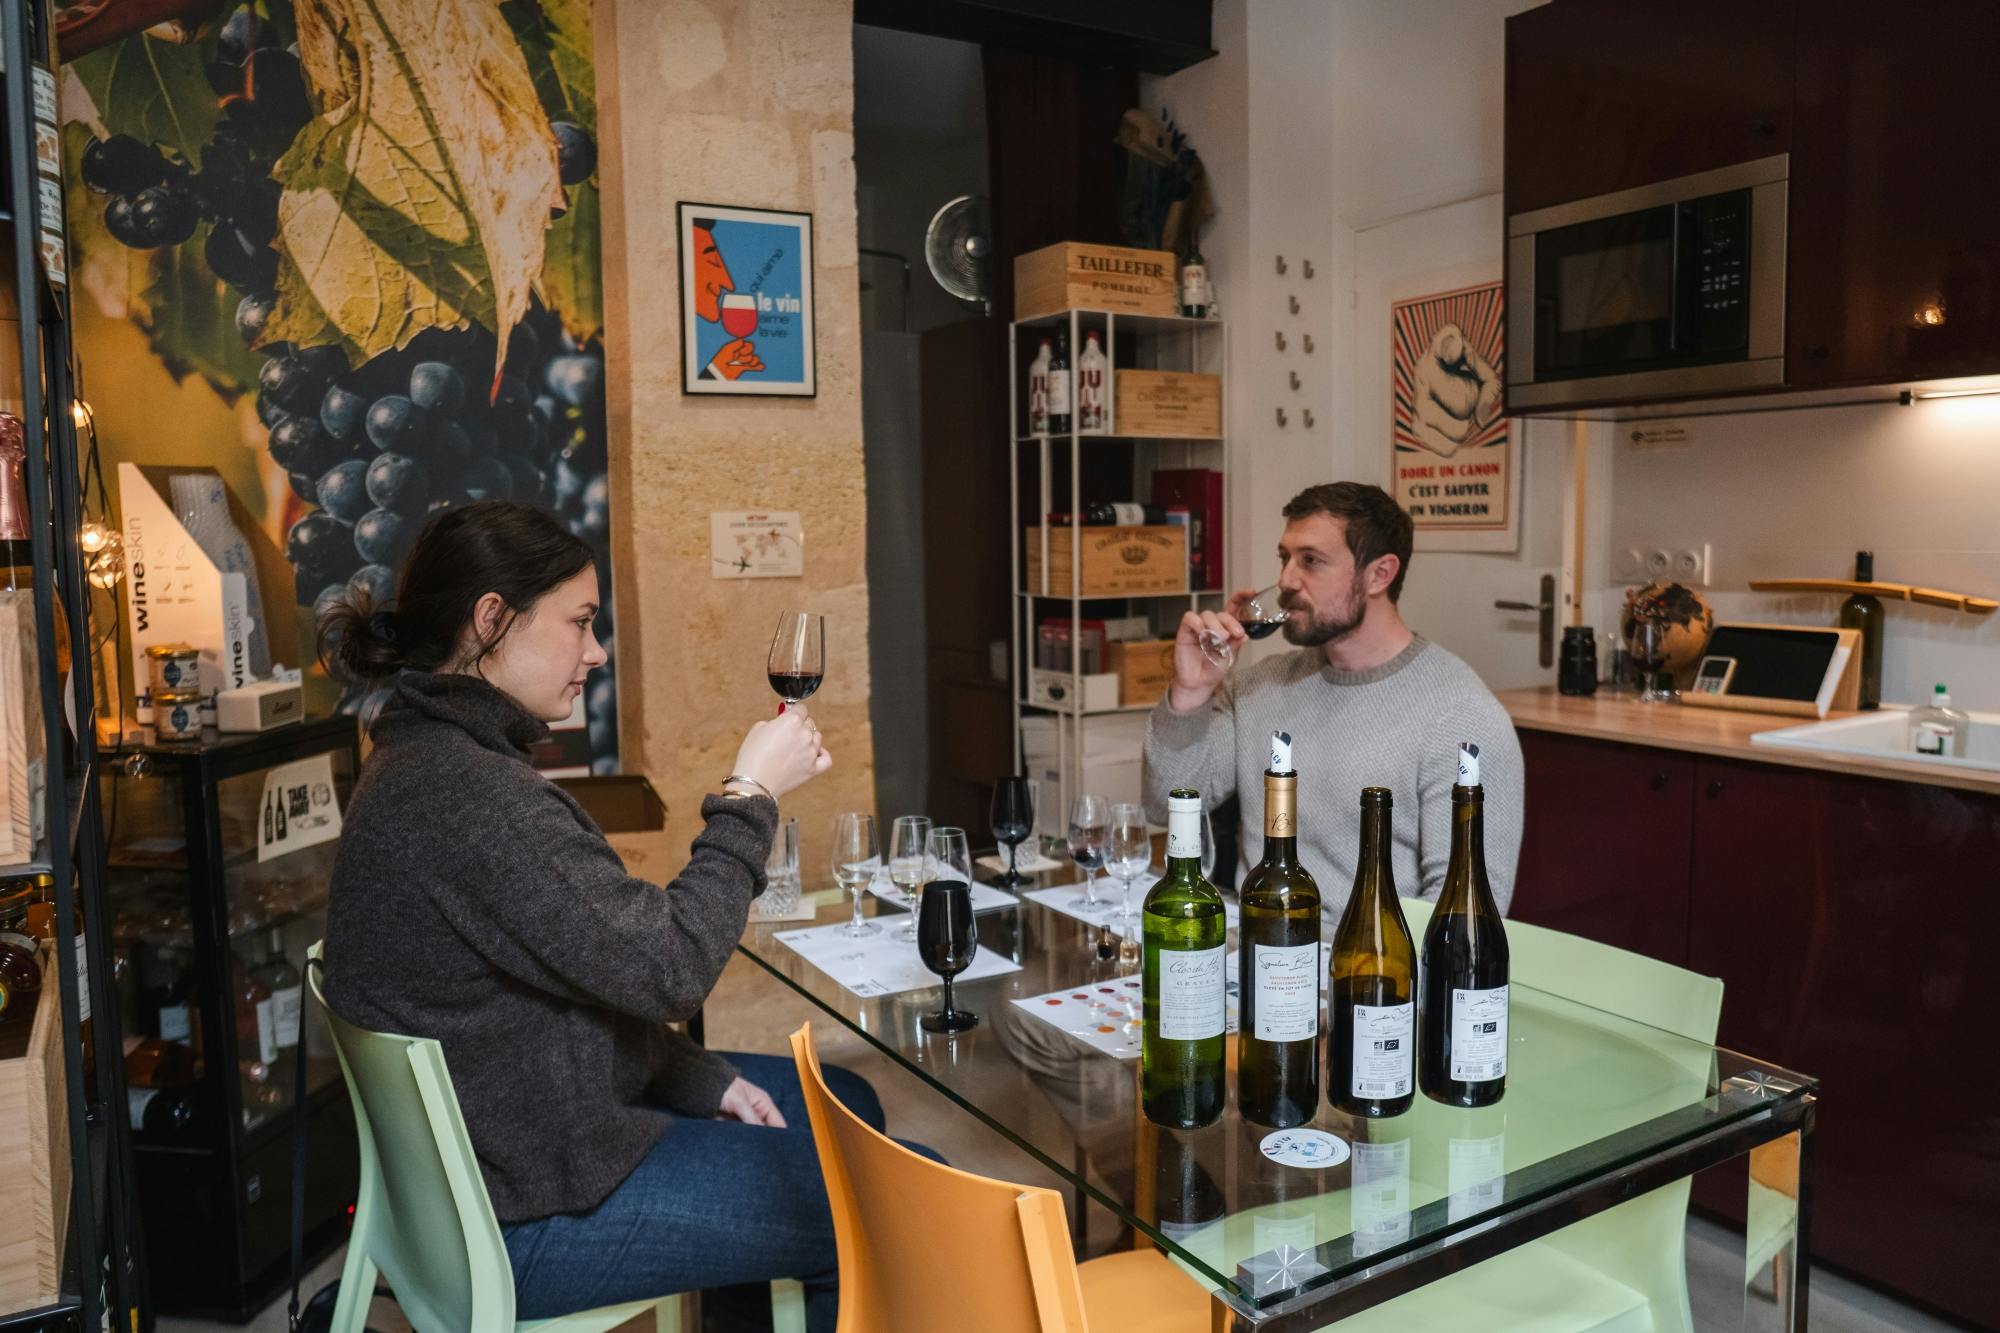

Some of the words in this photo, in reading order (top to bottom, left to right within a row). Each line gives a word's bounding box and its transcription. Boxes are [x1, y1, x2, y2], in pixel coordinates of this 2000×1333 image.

[751, 273, 764, 294] qui
[763, 248, 784, 278] aime
[1077, 255, 1164, 278] TAILLEFER
[757, 292, 773, 312] le
[776, 293, 800, 313] vin
[758, 315, 790, 325] aime
[1400, 467, 1434, 479] BOIRE
[1440, 465, 1455, 478] UN
[1460, 463, 1500, 477] CANON
[1409, 484, 1440, 497] C'EST
[1444, 483, 1489, 496] SAUVER
[1409, 504, 1424, 515] UN
[1429, 503, 1489, 516] VIGNERON
[127, 516, 149, 633] wineskin
[287, 784, 308, 803] TAKE
[289, 799, 310, 819] AWAY
